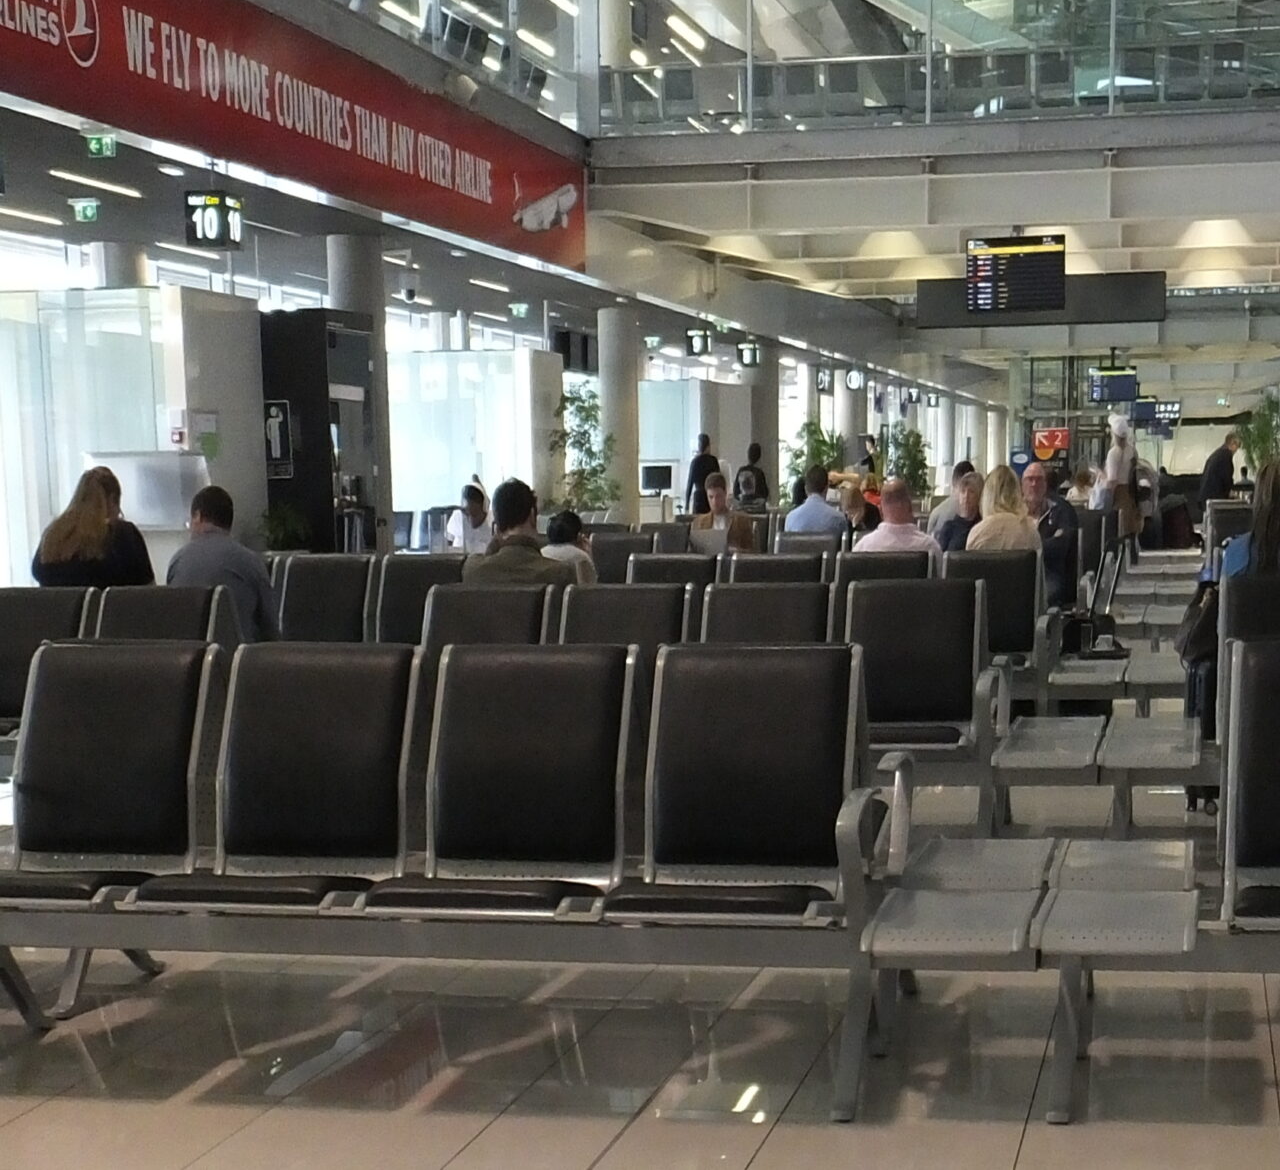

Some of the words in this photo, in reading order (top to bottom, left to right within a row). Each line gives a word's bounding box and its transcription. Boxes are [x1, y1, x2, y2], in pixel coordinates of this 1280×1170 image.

[122, 5, 157, 80] WE
[160, 21, 191, 92] FLY
[196, 37, 219, 103] TO
[224, 48, 271, 123] MORE
[274, 70, 352, 152] COUNTRIES
[354, 104, 388, 166] THAN
[391, 121, 414, 175] ANY
[418, 132, 453, 190] OTHER
[454, 148, 493, 205] AIRLINE
[192, 207, 218, 240] 10
[1054, 431, 1062, 445] 2
